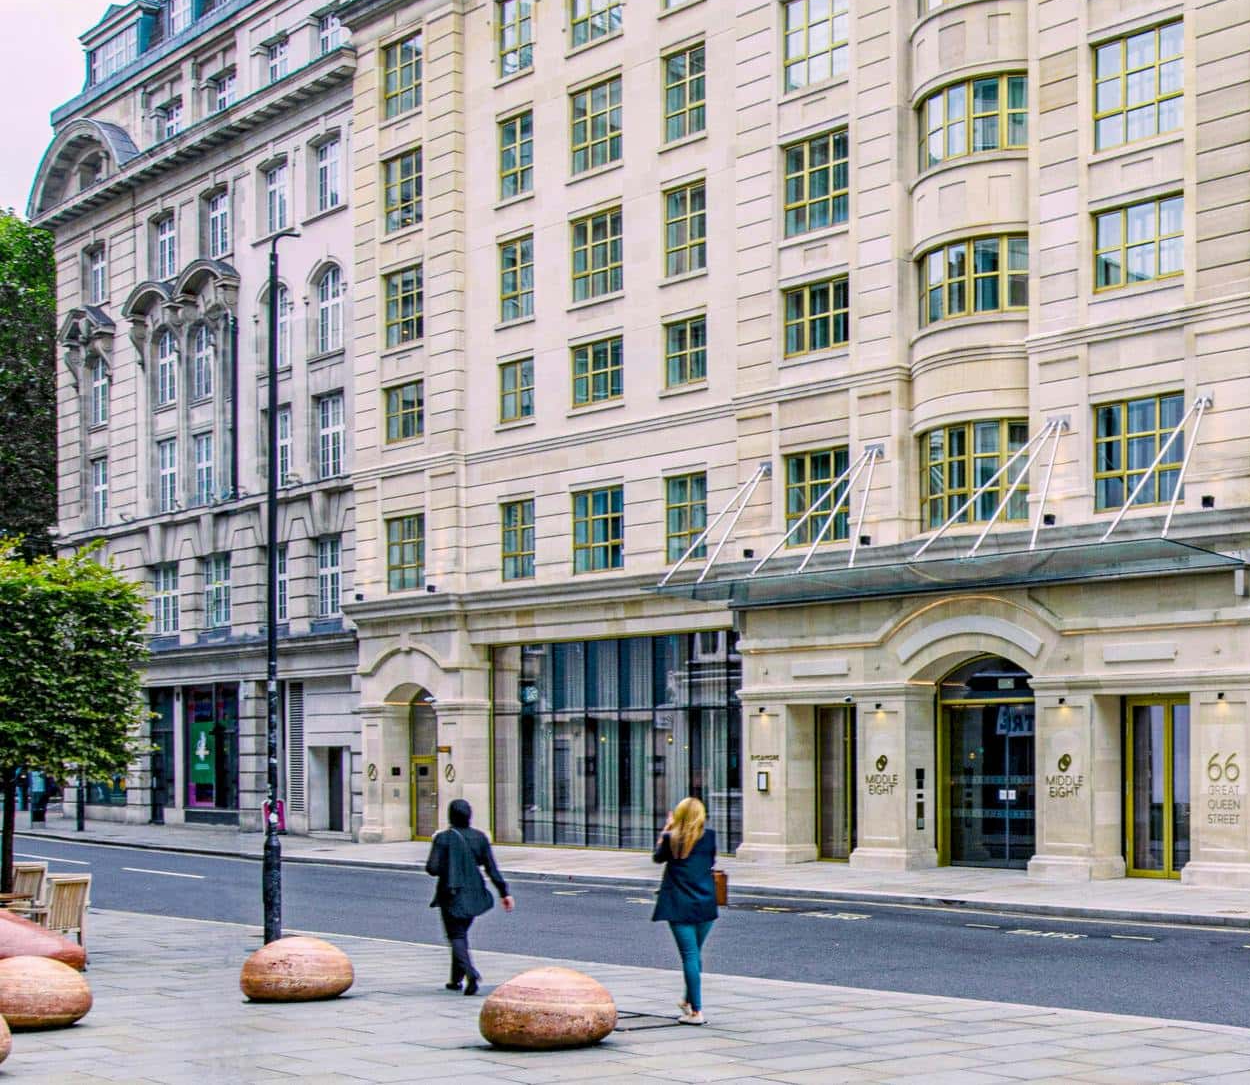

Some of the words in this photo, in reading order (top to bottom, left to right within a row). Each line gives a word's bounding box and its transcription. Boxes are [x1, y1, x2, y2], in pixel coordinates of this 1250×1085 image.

[1207, 752, 1240, 782] 66
[865, 774, 898, 785] MIDDLE
[1046, 775, 1084, 786] MIDDLE
[868, 784, 895, 796] EIGHT
[1049, 786, 1080, 798] EIGHT
[1207, 785, 1240, 796] GREAT
[1207, 799, 1241, 811] QUEEN
[1207, 813, 1240, 825] STREET
